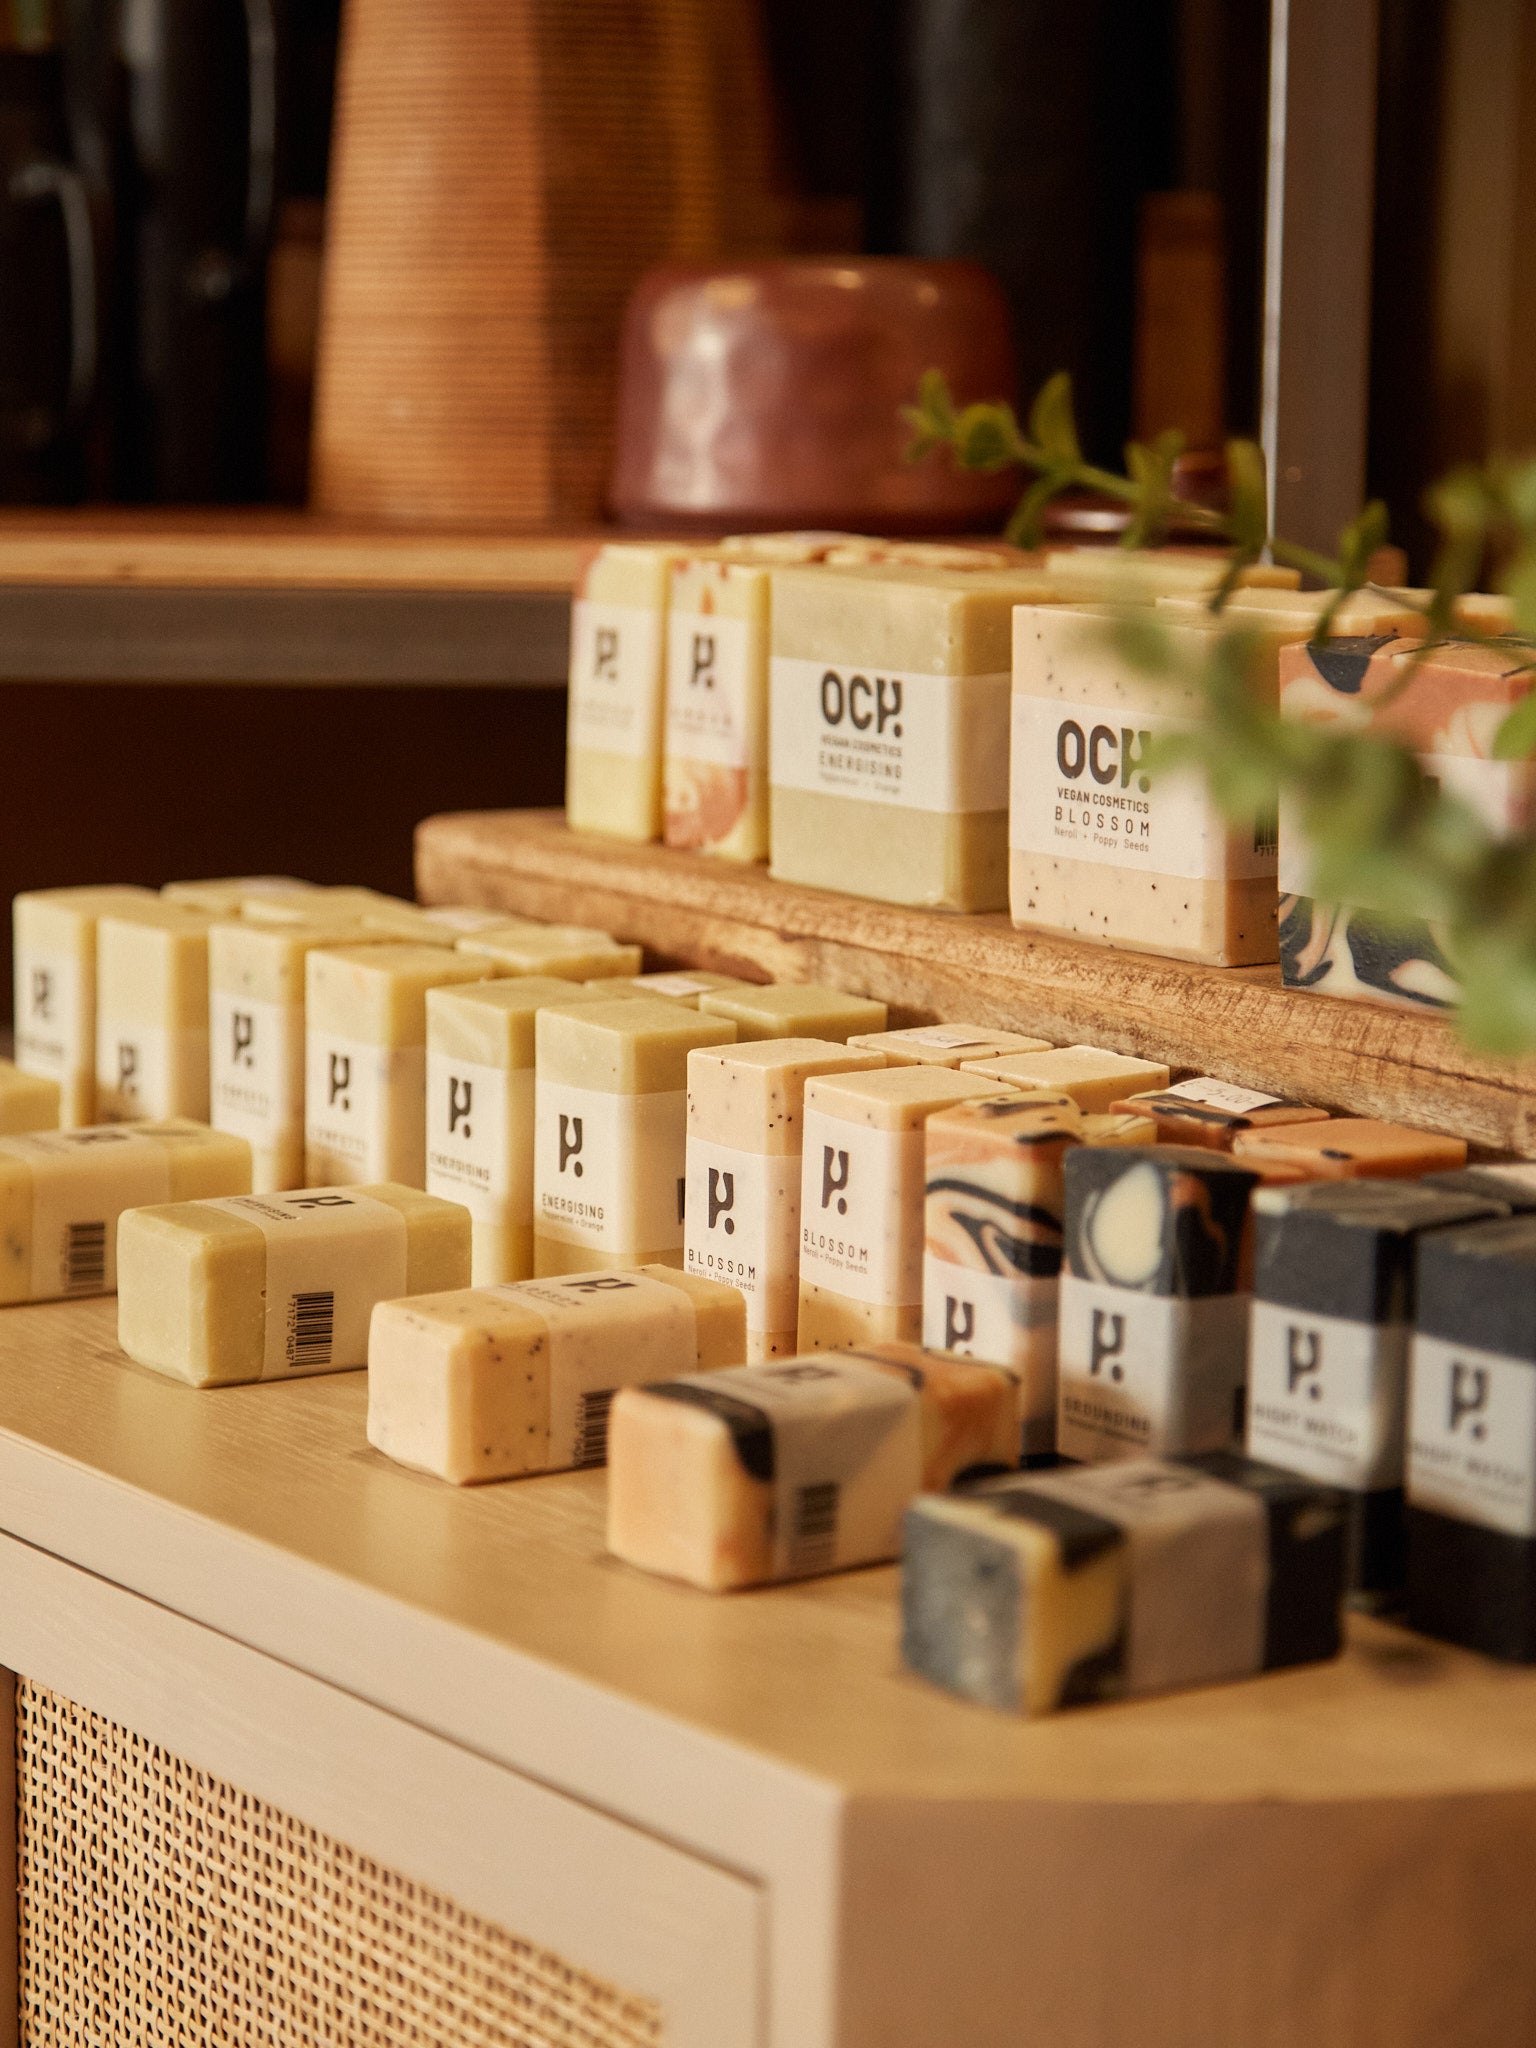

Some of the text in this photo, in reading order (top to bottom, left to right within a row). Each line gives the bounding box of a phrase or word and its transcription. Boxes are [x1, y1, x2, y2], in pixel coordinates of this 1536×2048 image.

[819, 750, 902, 779] ENERGISING
[1057, 787, 1150, 814] VEGAN COSMETICS
[1055, 805, 1150, 837] BLOSSOM
[1054, 826, 1078, 839] Neroli
[1093, 832, 1118, 849] Poppy
[1124, 838, 1150, 852] Seeds
[430, 1151, 491, 1180] ENERGISING
[542, 1192, 605, 1220] ENERGISING
[804, 1228, 868, 1262] BLOSSOM
[688, 1248, 756, 1280] BLOSSOM
[688, 1264, 708, 1278] Neroli
[735, 1278, 756, 1292] Seeds
